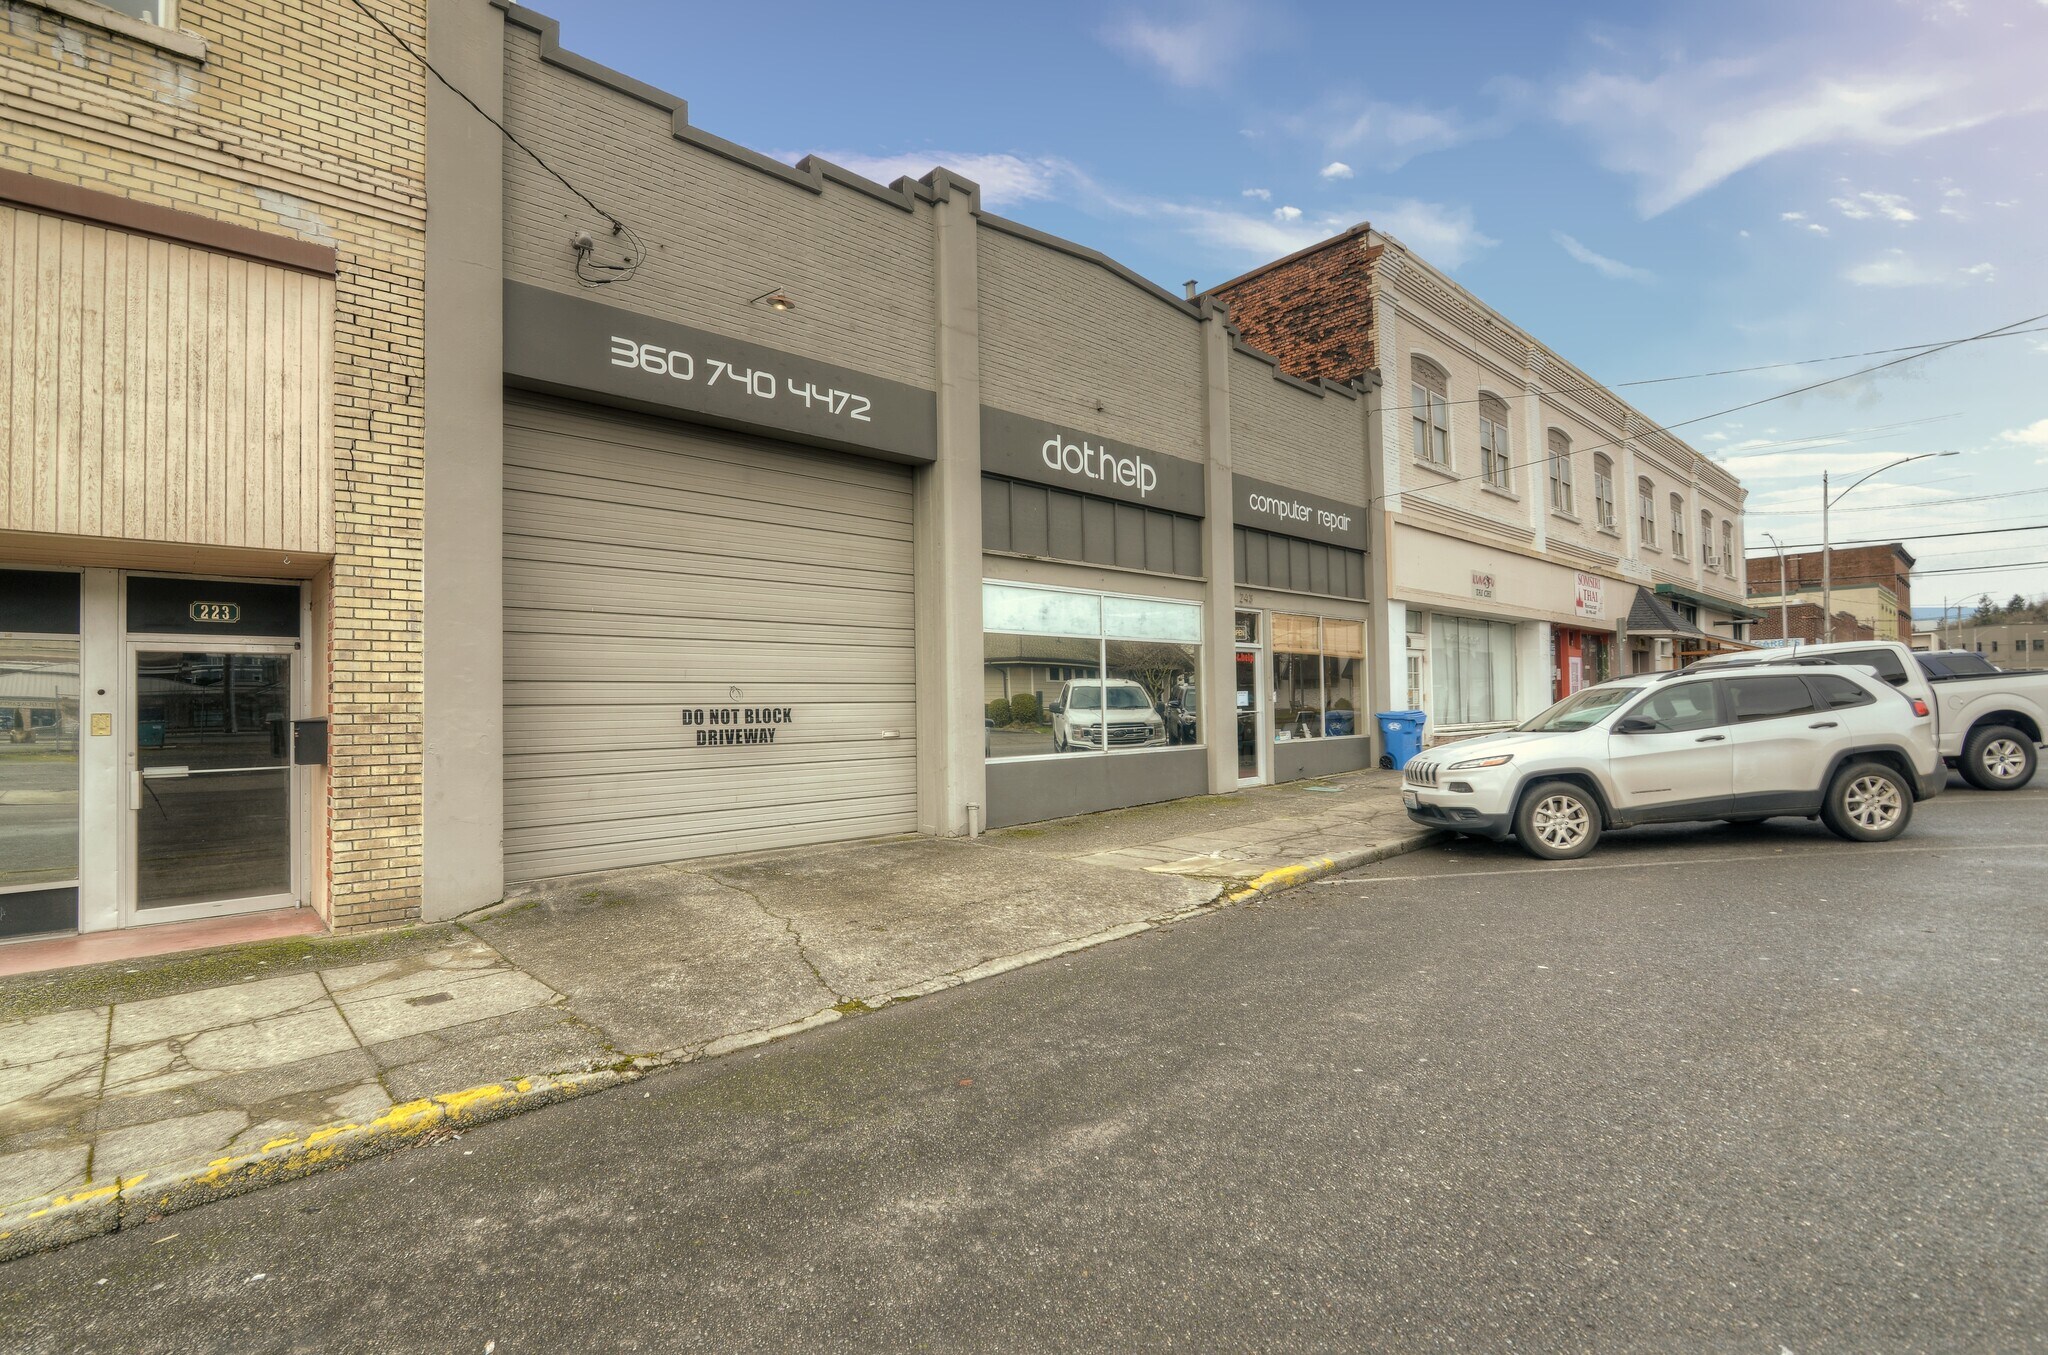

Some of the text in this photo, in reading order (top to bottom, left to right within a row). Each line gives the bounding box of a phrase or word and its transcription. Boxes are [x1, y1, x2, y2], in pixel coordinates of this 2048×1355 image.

[611, 336, 871, 422] 360 740 4472
[1042, 434, 1157, 498] dot.help
[1249, 493, 1351, 532] computer repair
[1583, 589, 1598, 602] THAI
[200, 604, 230, 620] 223
[682, 707, 792, 726] DO NOT BLOCK
[696, 728, 776, 746] DRIVEWAY
